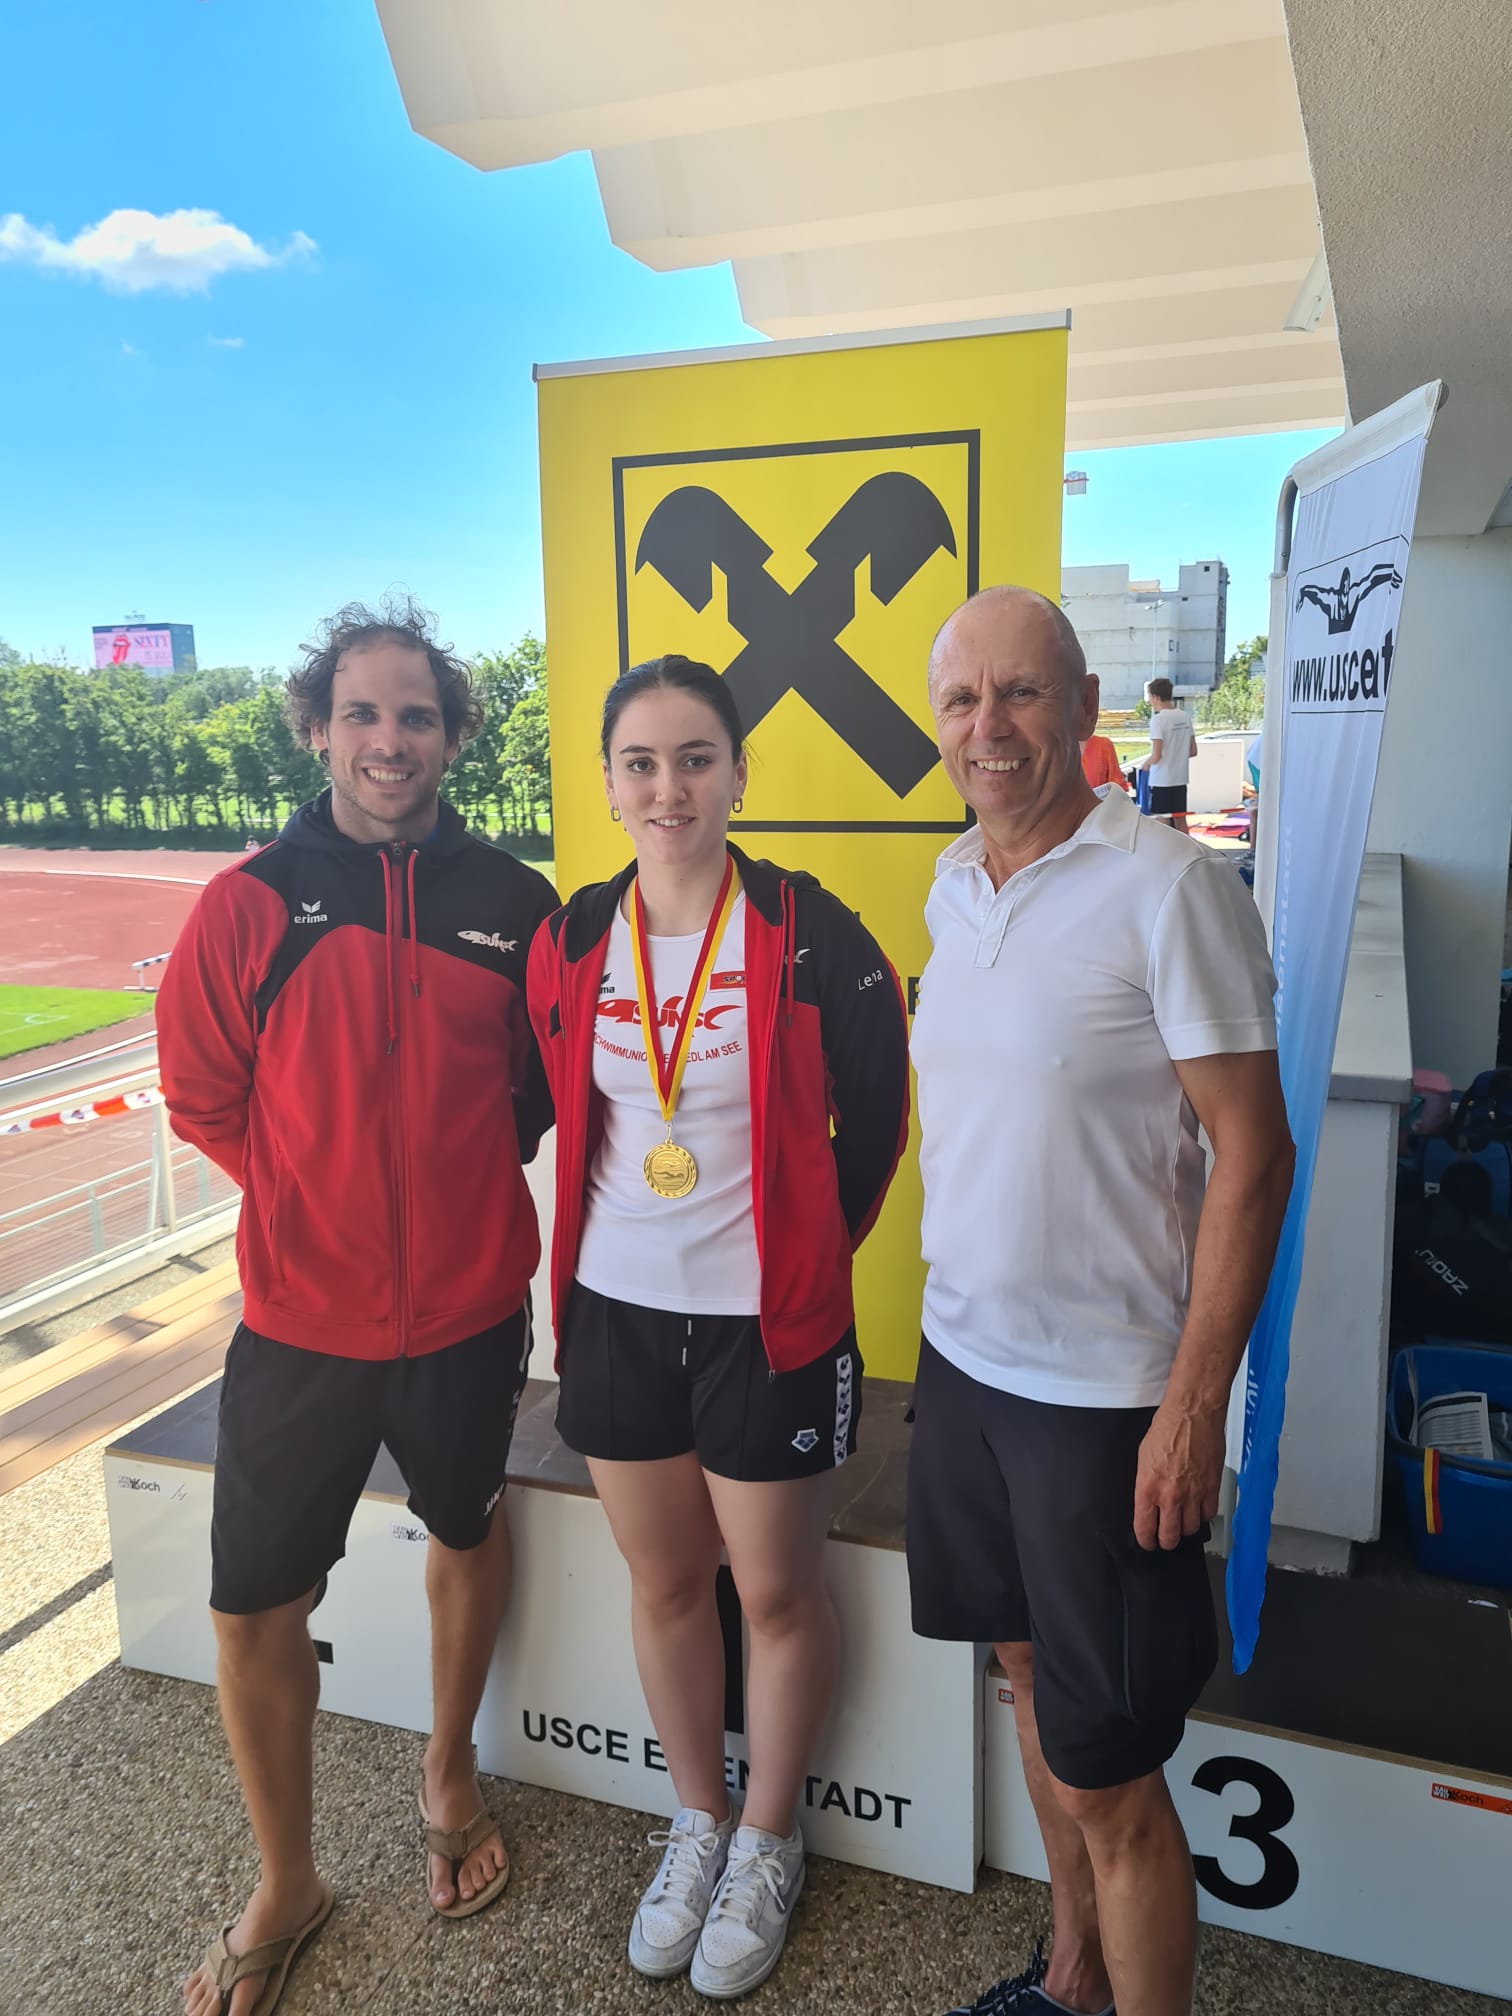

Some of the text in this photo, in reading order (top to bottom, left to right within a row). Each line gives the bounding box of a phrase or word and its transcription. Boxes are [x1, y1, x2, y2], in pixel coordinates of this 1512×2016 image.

[294, 912, 328, 924] erima
[594, 1033, 648, 1062] CHWIMMUNIO
[705, 1047, 721, 1061] AM
[721, 1040, 743, 1056] SEE
[522, 1709, 630, 1764] USCE
[1190, 1755, 1300, 1911] 3
